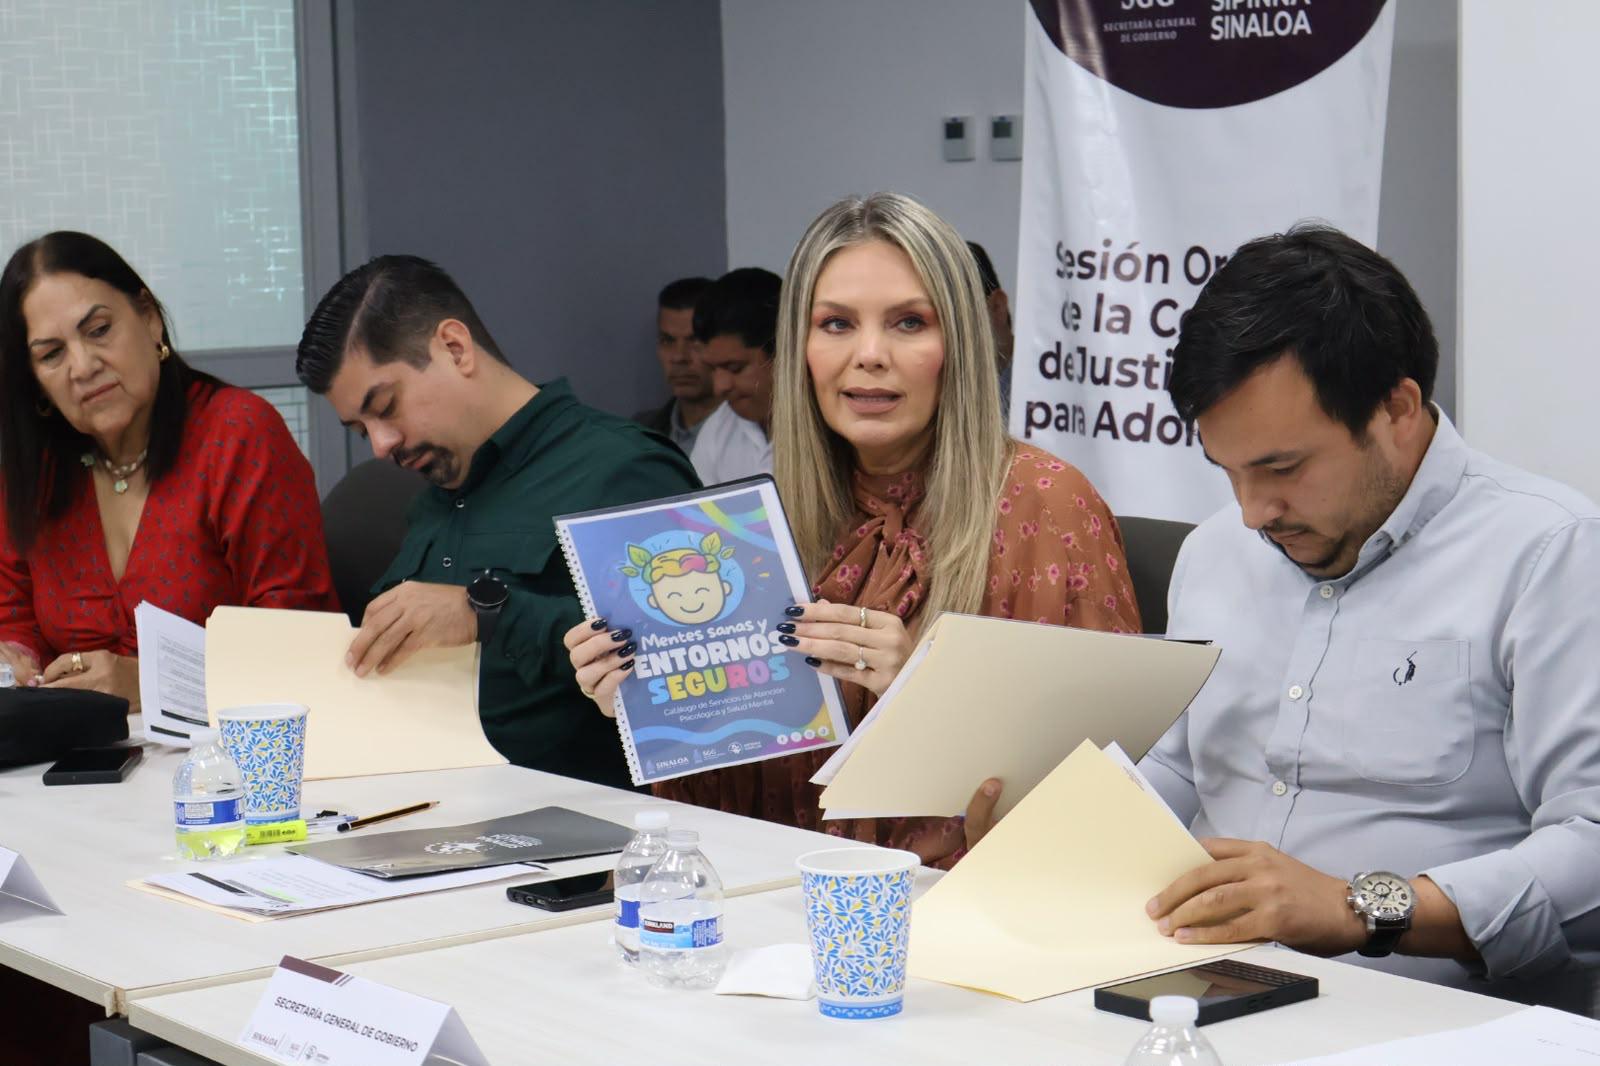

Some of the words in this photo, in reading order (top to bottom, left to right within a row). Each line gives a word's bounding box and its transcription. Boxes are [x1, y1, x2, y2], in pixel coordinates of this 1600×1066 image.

[1155, 17, 1197, 28] GENERAL
[1210, 9, 1312, 40] SINALOA
[1183, 245, 1228, 287] Or
[1093, 293, 1132, 335] la
[1150, 298, 1193, 338] C
[1039, 341, 1074, 381] de
[1076, 346, 1173, 390] Justi
[1024, 400, 1086, 439] para
[1093, 400, 1203, 446] Adol
[634, 630, 789, 679] ENTORNOS
[641, 630, 704, 651] Mentes
[707, 620, 754, 638] sanas
[757, 618, 768, 635] y
[648, 655, 790, 705] SEGUROS
[698, 701, 708, 709] de
[708, 696, 742, 707] Servicios
[742, 692, 752, 701] de
[726, 703, 748, 713] Salud
[749, 698, 775, 710] Mental
[274, 996, 323, 1020] SECRETARÍA
[323, 1012, 360, 1034] GENERAL
[360, 1025, 375, 1038] DE
[374, 1029, 419, 1052] GOBIERNO
